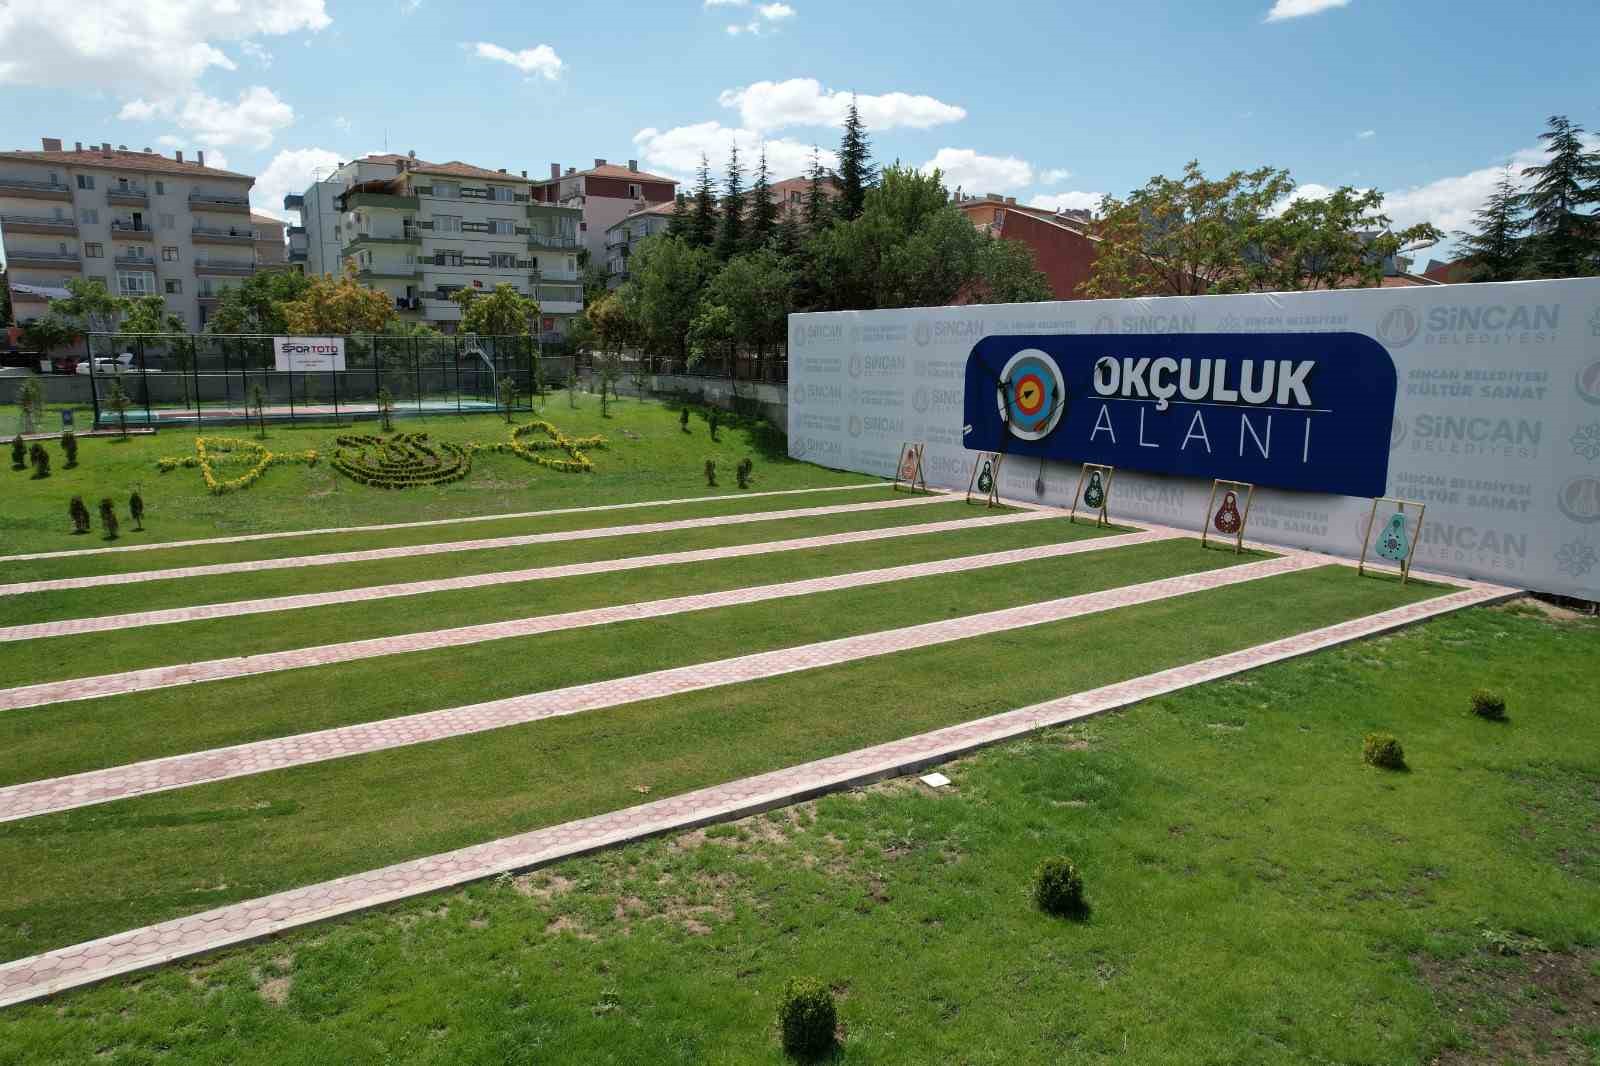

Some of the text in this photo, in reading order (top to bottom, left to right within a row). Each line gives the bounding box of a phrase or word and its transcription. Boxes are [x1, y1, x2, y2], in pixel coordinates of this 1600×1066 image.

[1093, 355, 1316, 411] OKÇULUK
[1479, 384, 1547, 400] SANAT
[1090, 403, 1311, 463] ALANI
